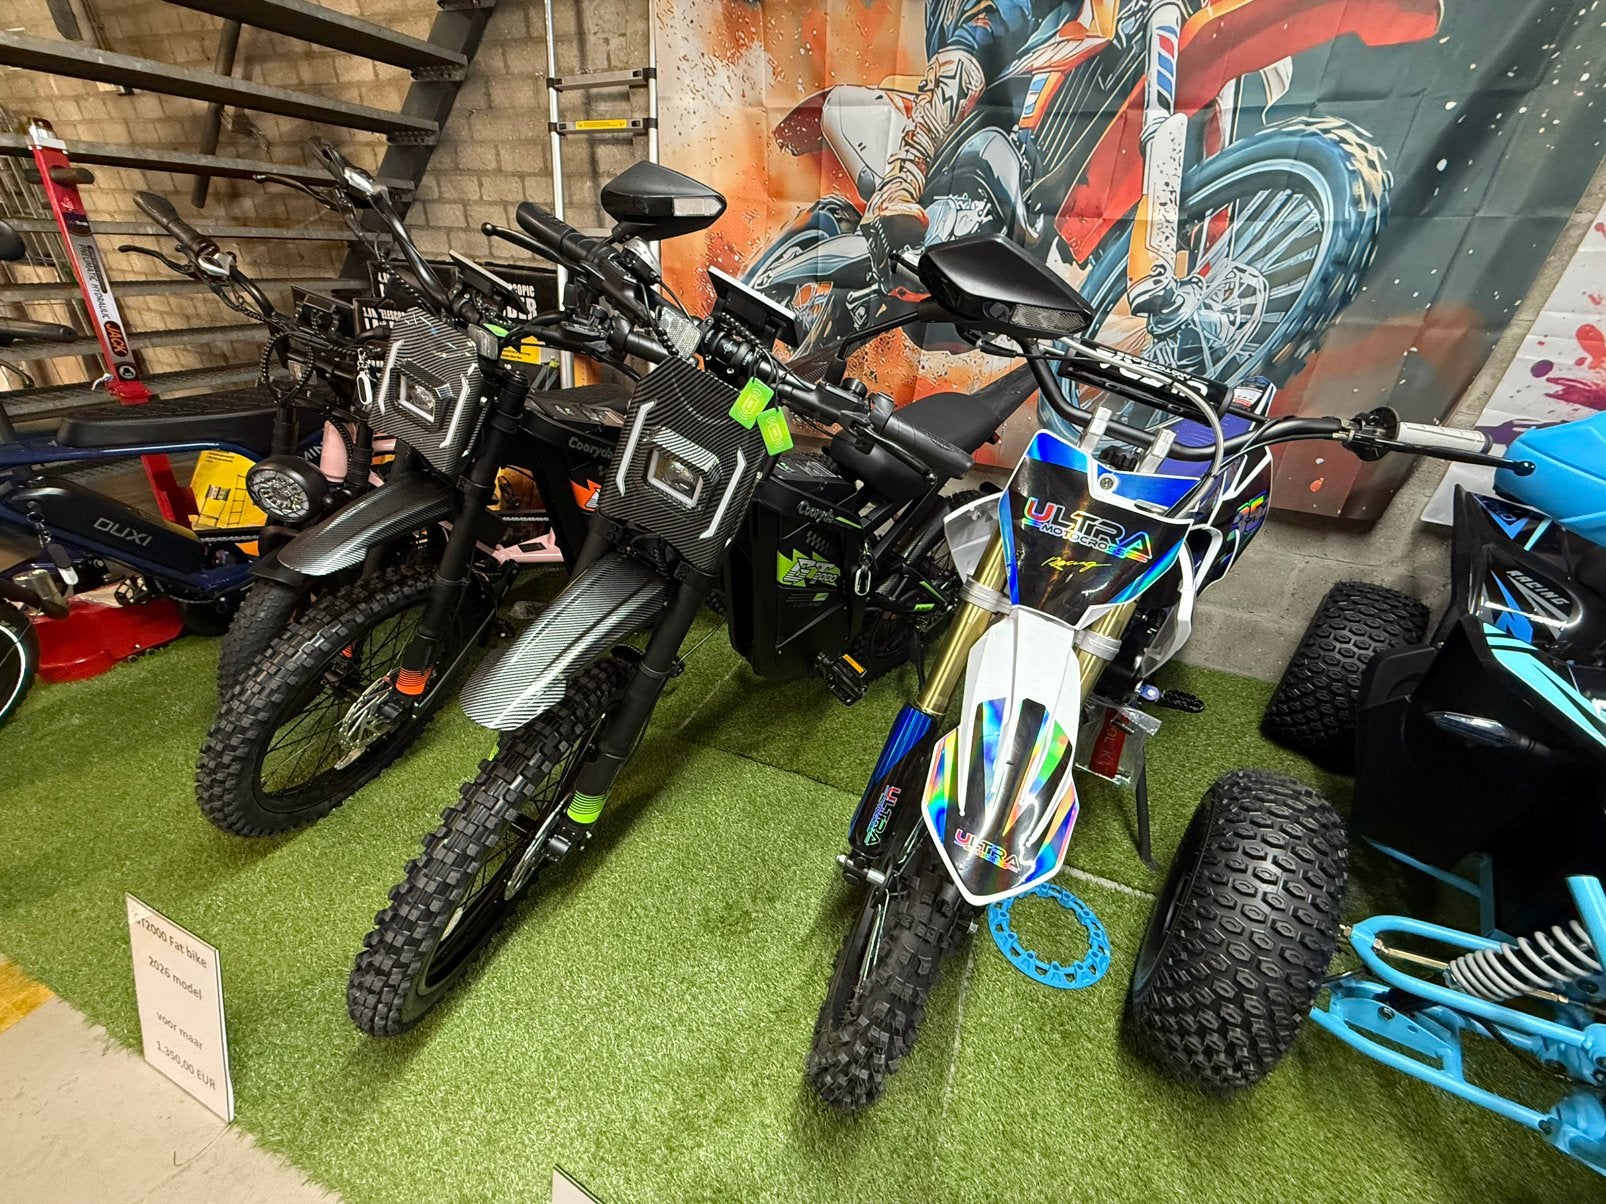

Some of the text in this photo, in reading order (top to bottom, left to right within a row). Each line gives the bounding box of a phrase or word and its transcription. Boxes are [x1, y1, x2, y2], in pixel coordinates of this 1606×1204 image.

[78, 244, 97, 282] PNEUMATIC
[92, 284, 111, 319] HYDRAULIC
[106, 324, 127, 354] JACK
[92, 517, 154, 547] OUXI
[1023, 496, 1153, 561] ULTRA
[1040, 523, 1126, 559] MOTOCROSS
[815, 572, 838, 584] 2000
[1041, 555, 1113, 573] Racing
[1506, 569, 1571, 605] RACING
[864, 785, 902, 847] ULTRA
[954, 828, 1021, 872] ULTRA
[169, 935, 184, 954] Fat
[185, 945, 208, 969] bike
[148, 955, 203, 1000] 2026 model
[156, 1011, 203, 1051] voor maar
[156, 1040, 217, 1091] 1.350,00 EUR
